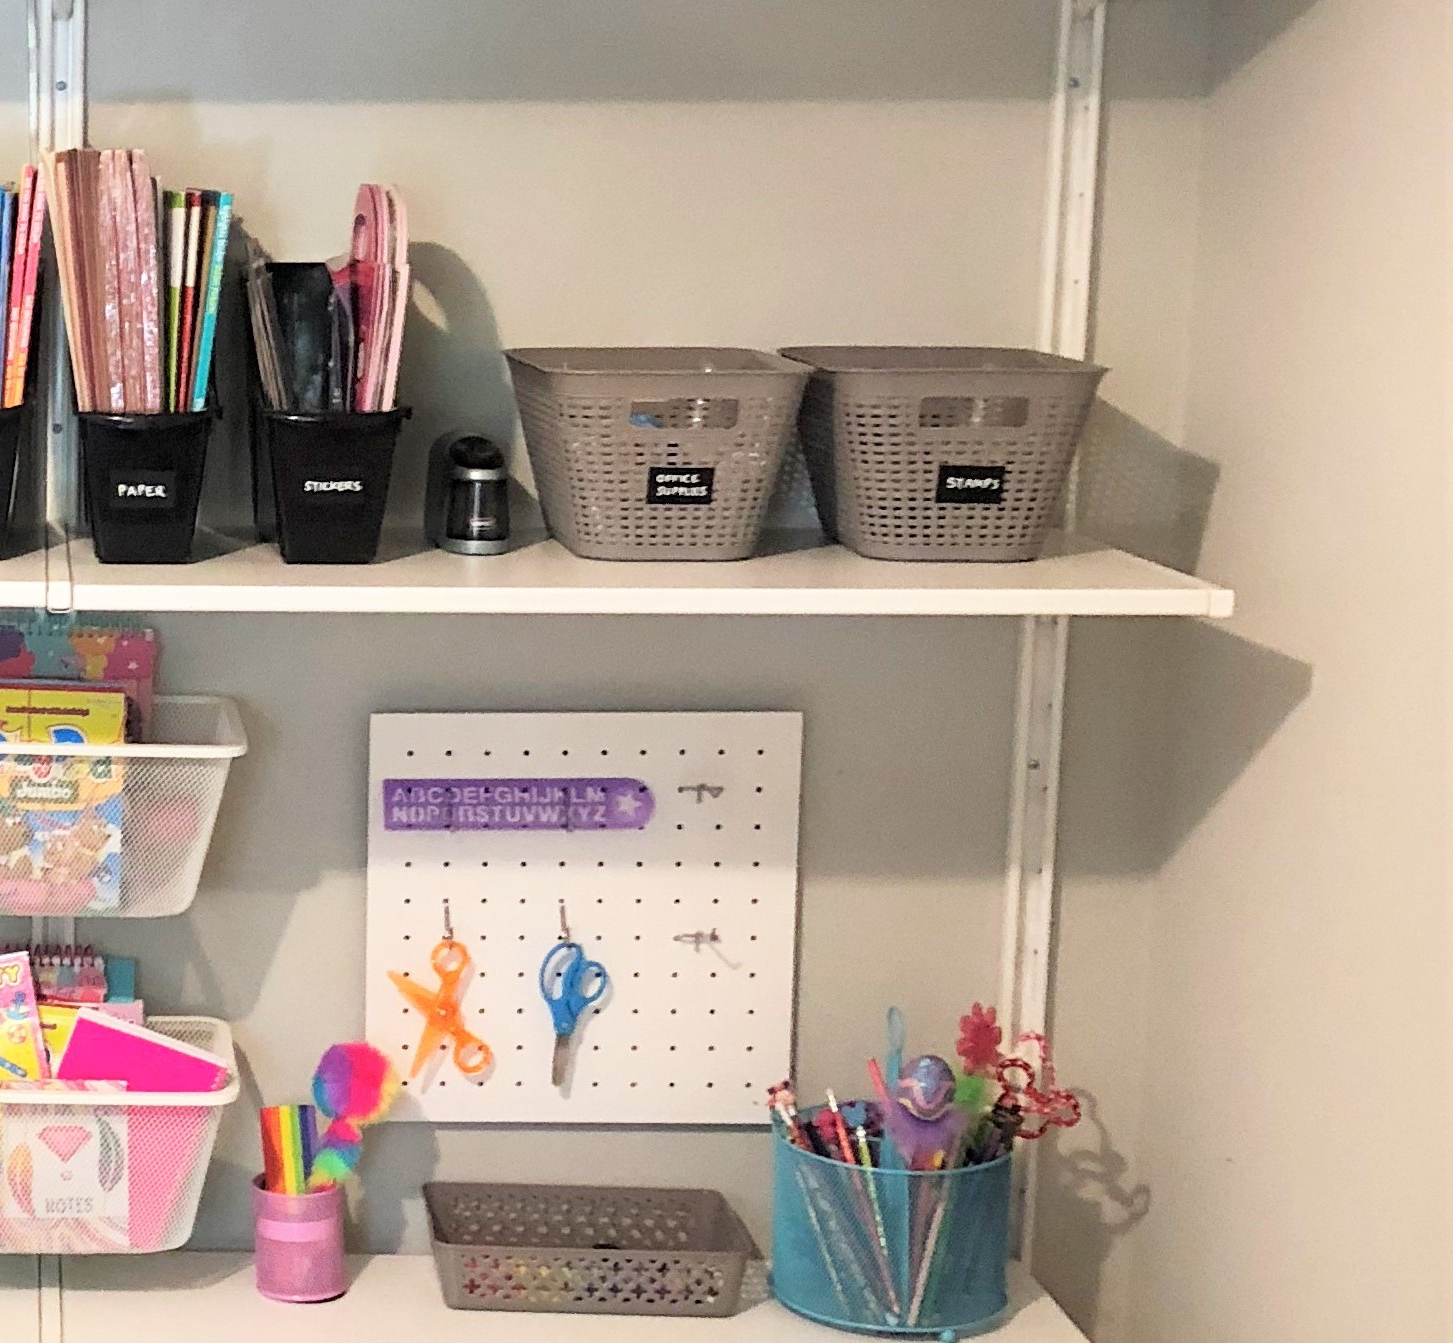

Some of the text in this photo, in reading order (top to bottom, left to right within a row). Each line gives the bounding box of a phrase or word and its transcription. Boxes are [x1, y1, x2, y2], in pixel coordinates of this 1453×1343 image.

[655, 473, 701, 484] OFFICE
[945, 476, 1001, 490] STAMPS
[117, 483, 167, 498] PAPER
[303, 480, 364, 492] STICKERS
[655, 485, 709, 497] SUPPLIES
[45, 1196, 93, 1214] NOTES
